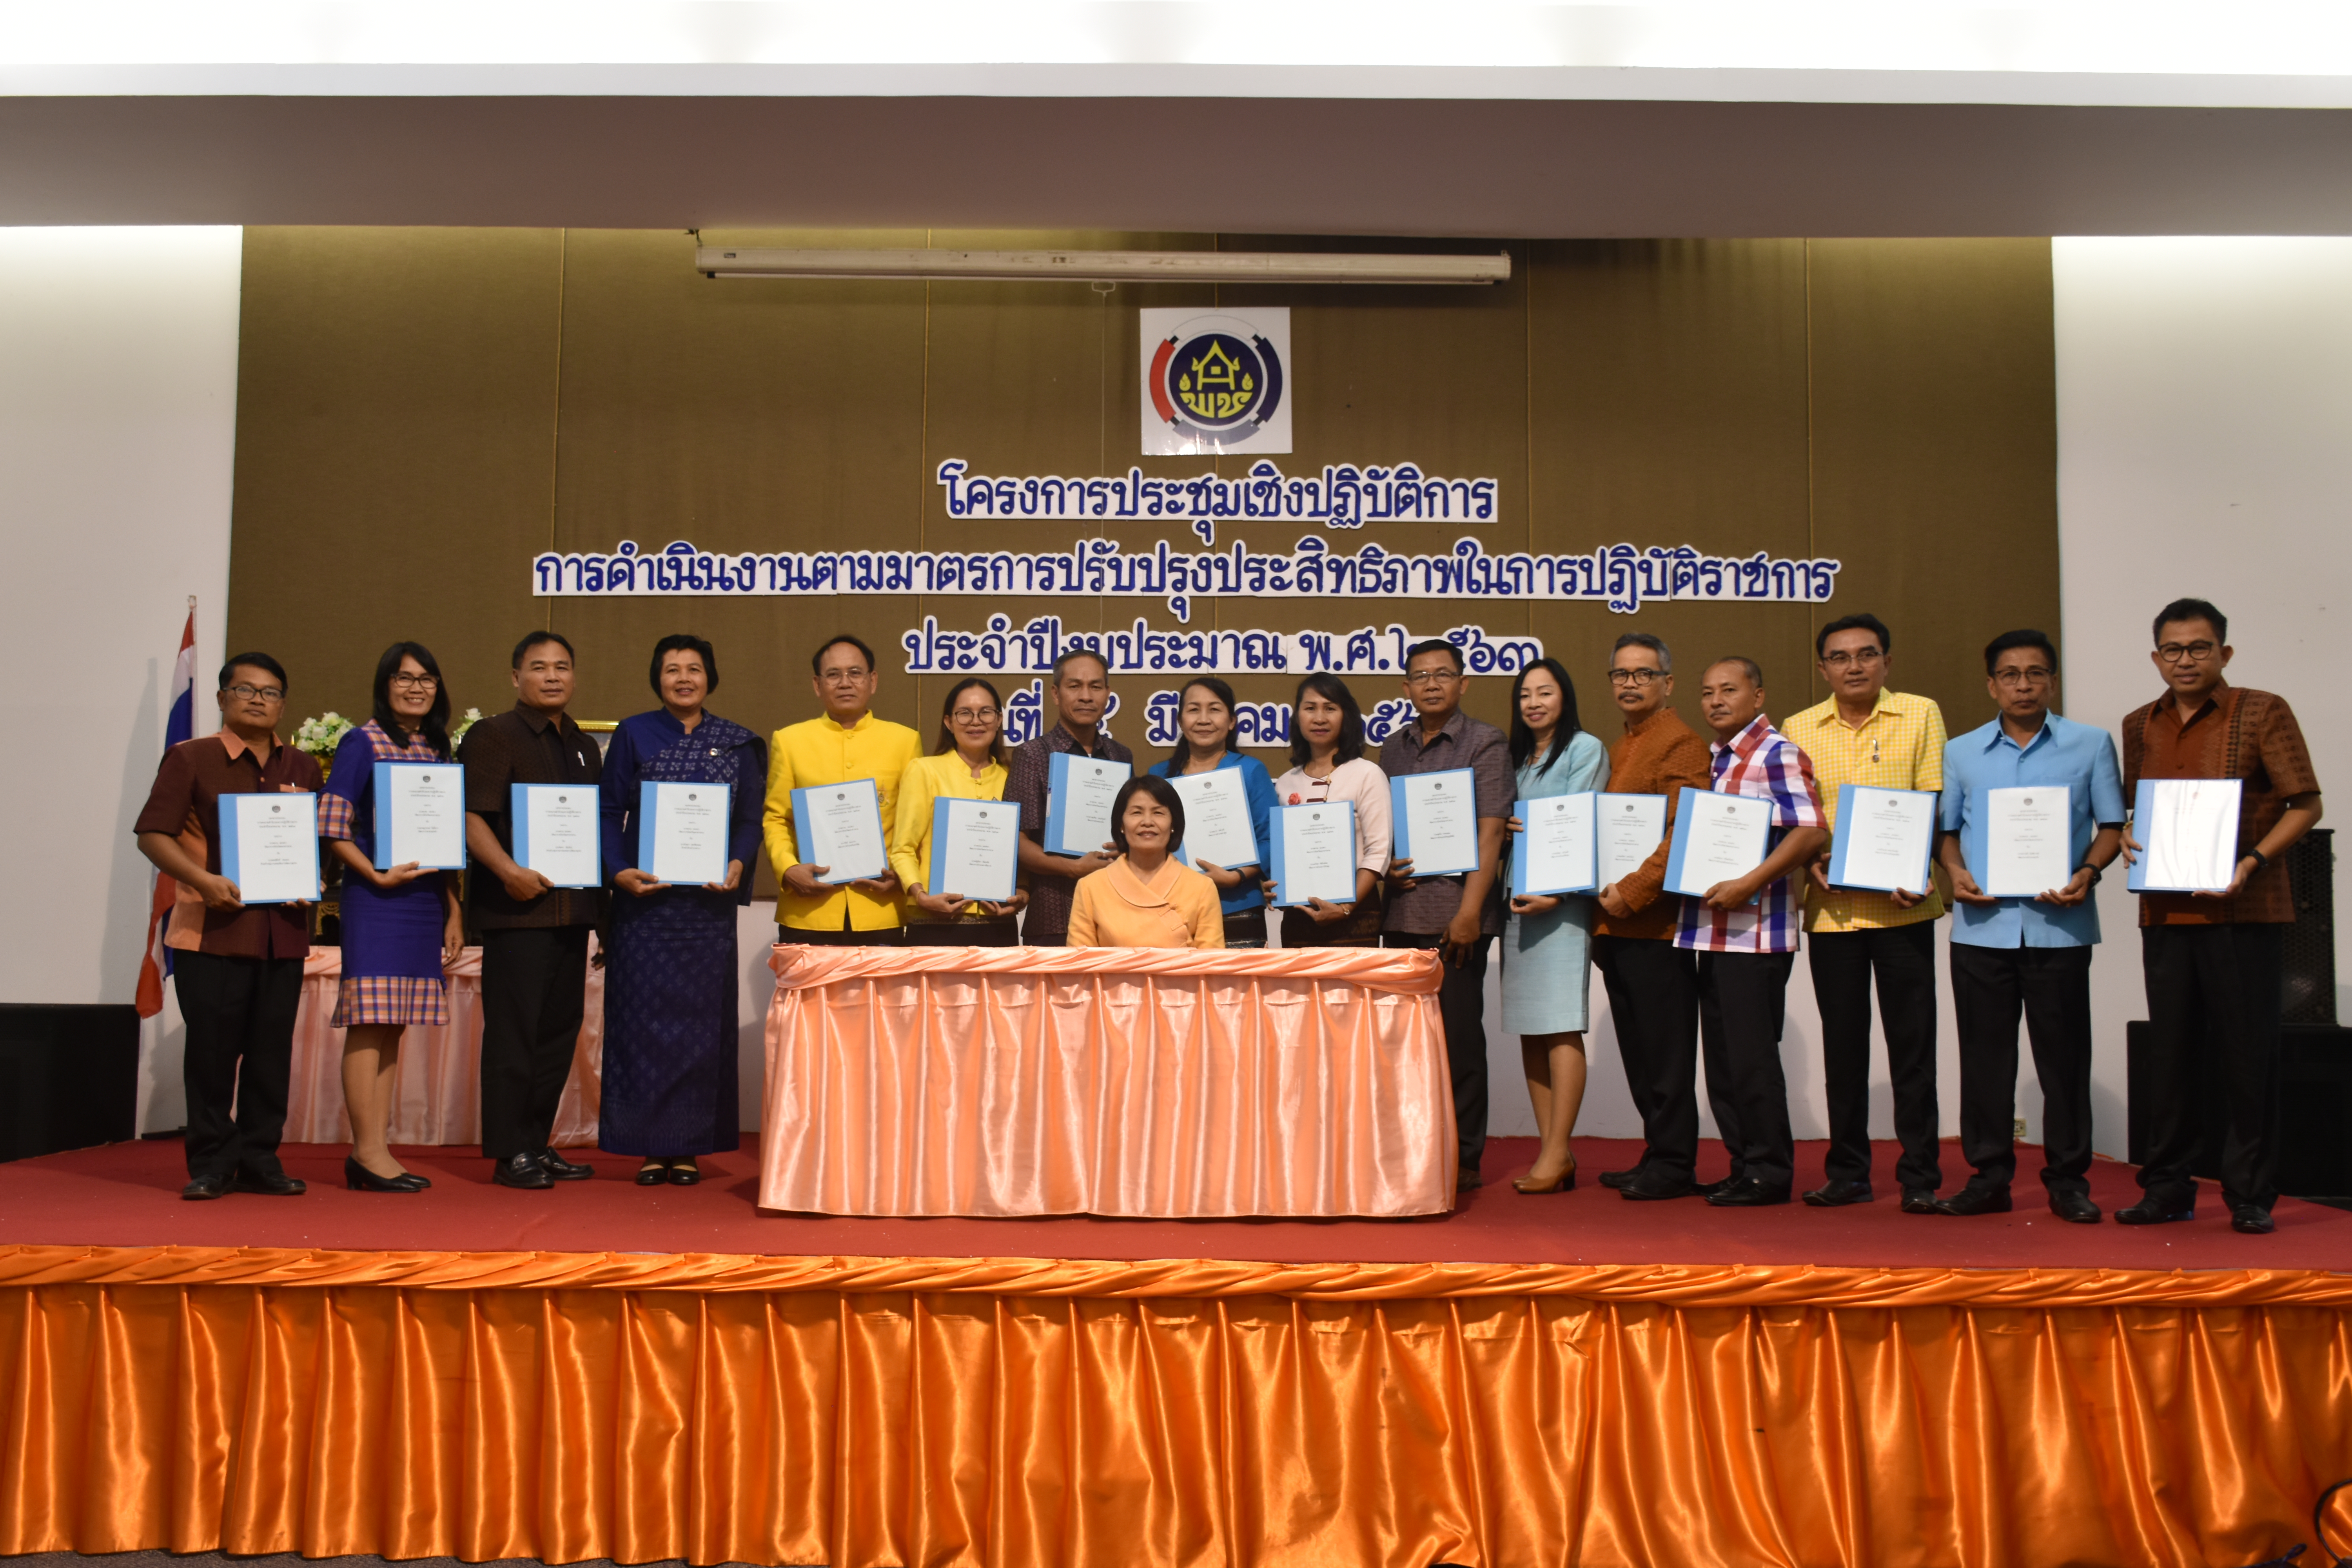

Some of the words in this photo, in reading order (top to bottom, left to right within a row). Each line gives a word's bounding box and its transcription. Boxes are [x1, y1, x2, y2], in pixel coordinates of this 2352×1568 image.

[940, 463, 1495, 543] โครงการประชุมเชิงปฏิบัติการ
[535, 537, 1838, 619] การดำเนินงานตามมาตรการปรับปรุงประสิทธิภาพในการปฏิบัติราชการ
[1148, 692, 1290, 742] มีคม
